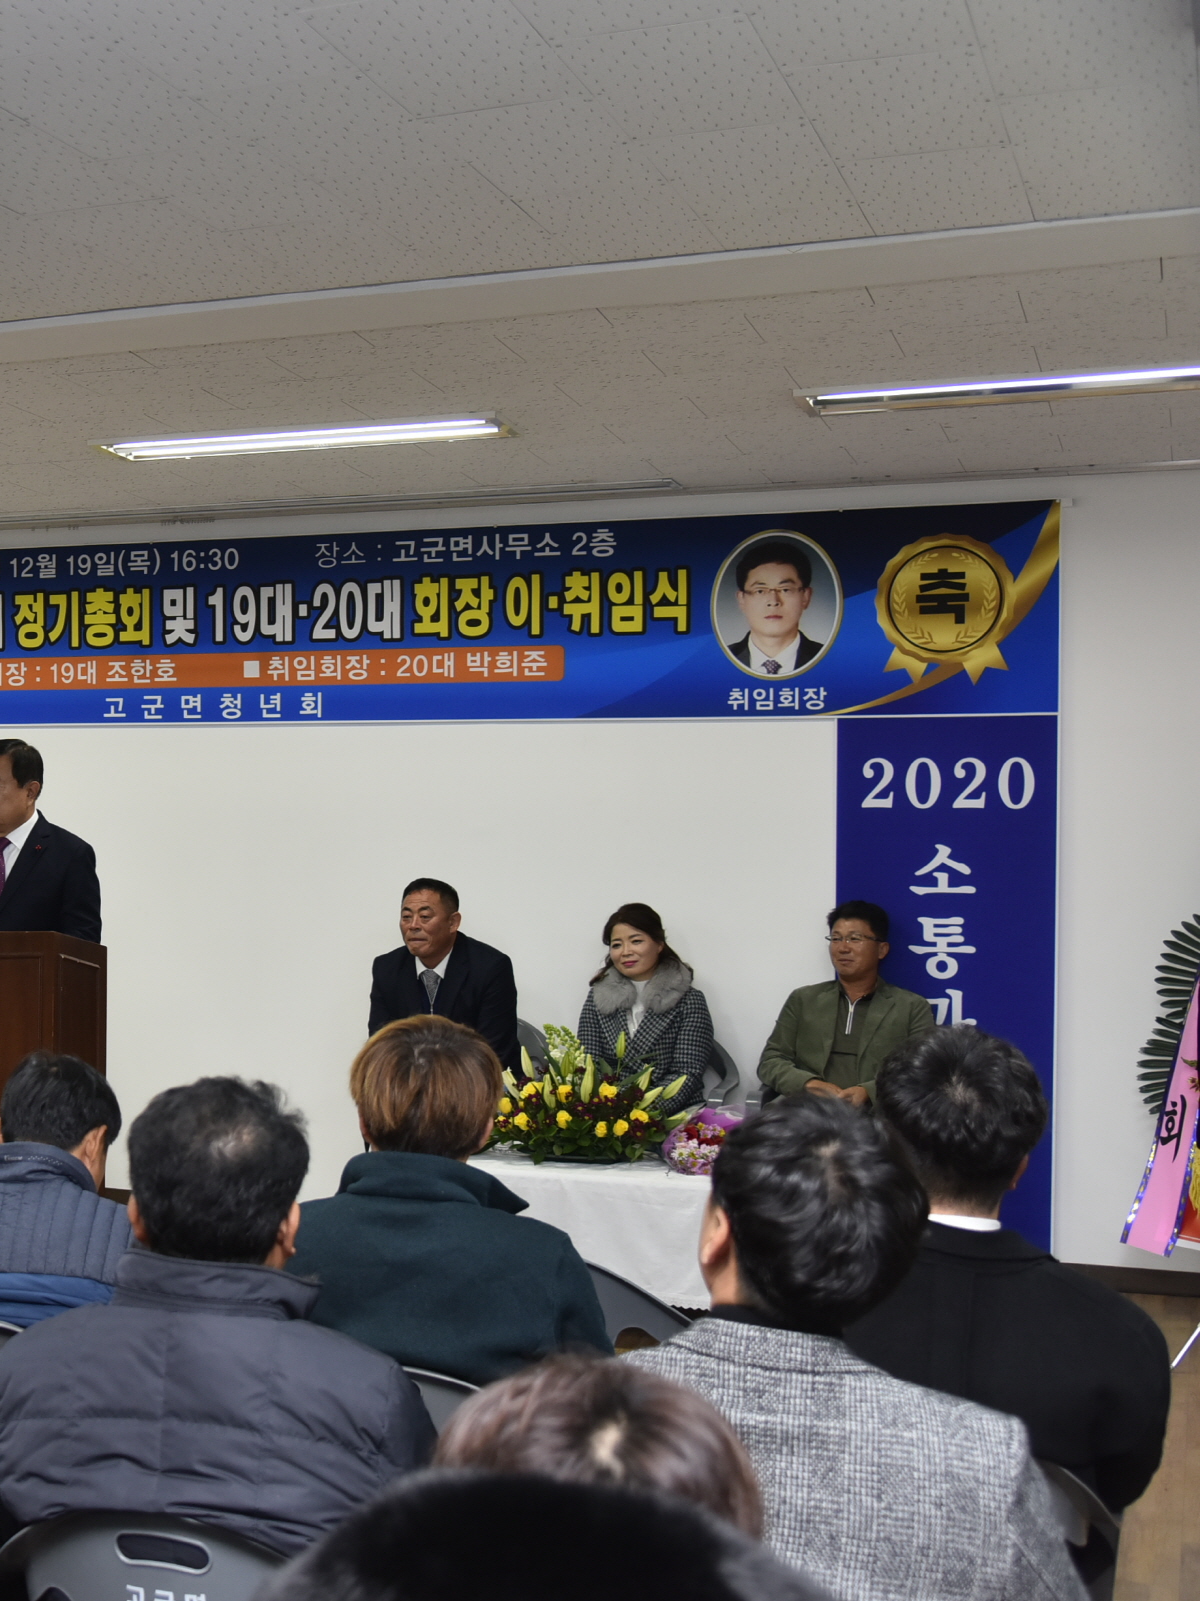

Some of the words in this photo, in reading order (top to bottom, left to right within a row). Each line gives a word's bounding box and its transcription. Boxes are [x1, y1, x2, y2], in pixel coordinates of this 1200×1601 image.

[9, 553, 56, 579] 12월
[66, 548, 161, 577] 19일(목)
[170, 548, 240, 572] 16:30
[315, 541, 366, 568] 장소
[392, 532, 561, 563] 고군면사무소
[572, 529, 617, 558] 2층
[14, 587, 150, 649] 정기총회
[163, 586, 196, 645] 및
[413, 575, 493, 638] 회장
[915, 568, 970, 624] 축
[50, 660, 97, 685] 19대
[105, 658, 177, 683] 조한호
[267, 654, 370, 682] 취임회장
[396, 652, 455, 678] 20대
[466, 650, 548, 678] 박희준
[727, 687, 827, 711] 취임회장
[861, 757, 1036, 809] 2020
